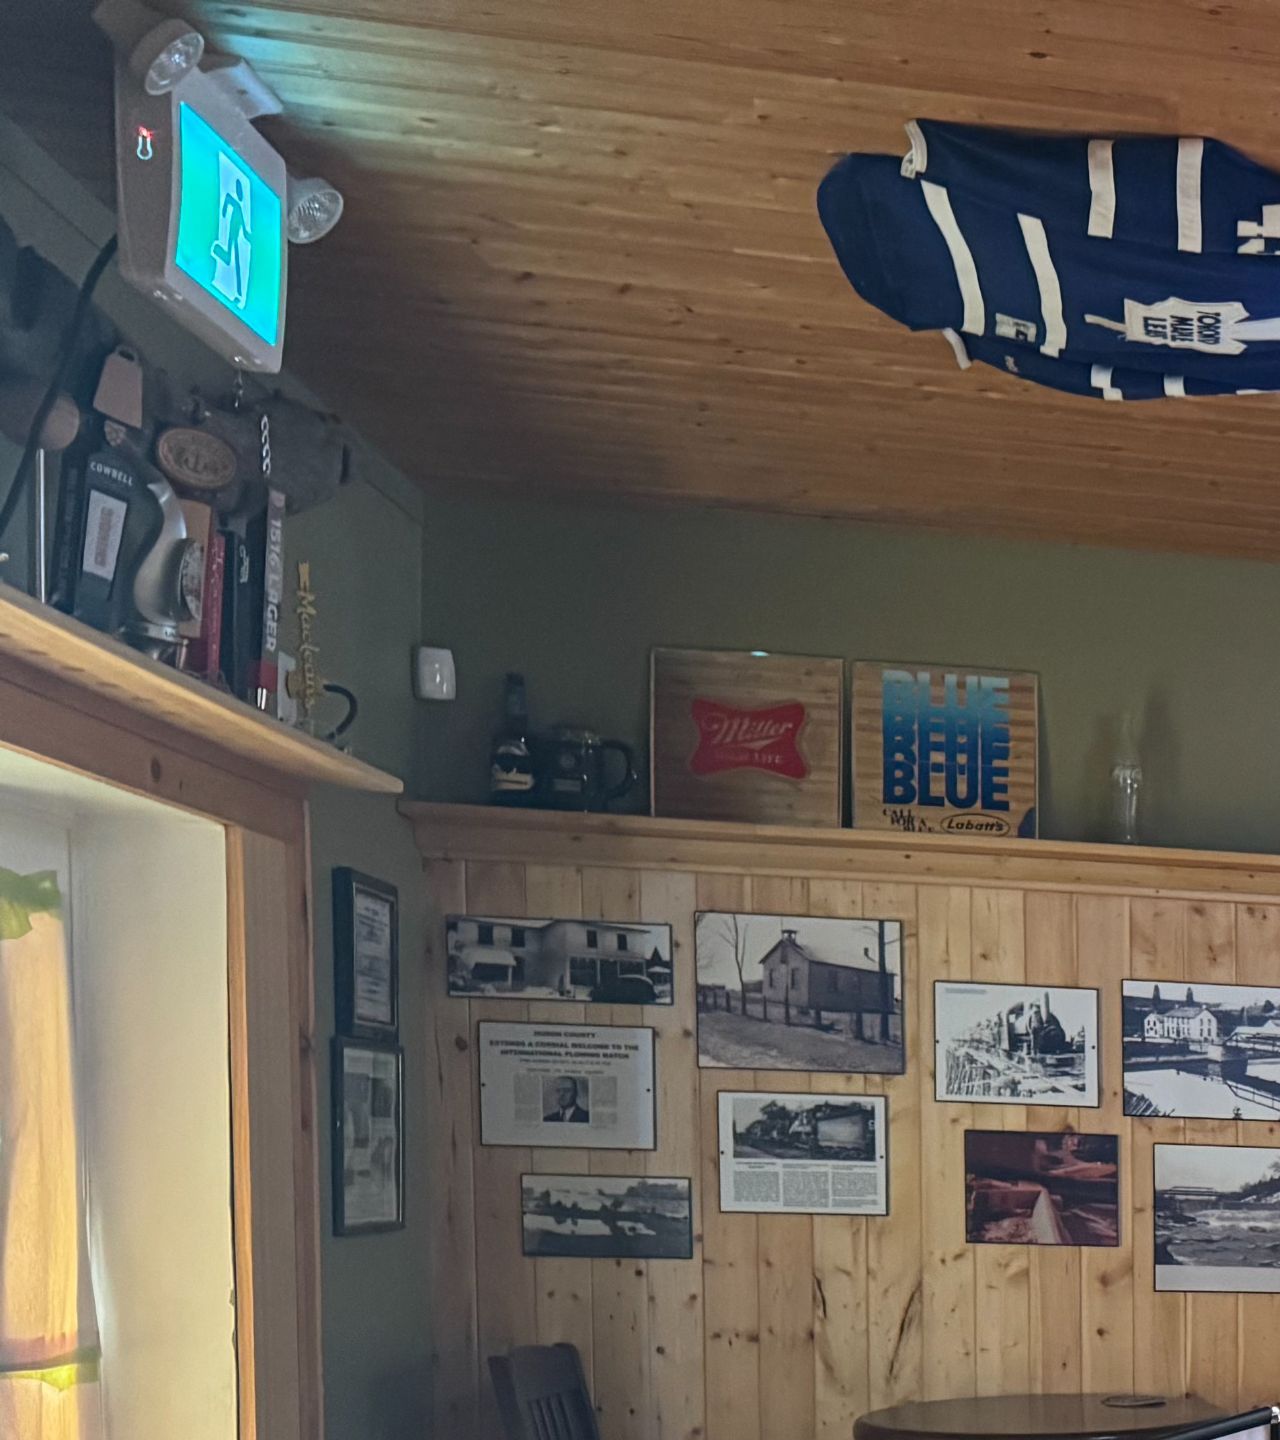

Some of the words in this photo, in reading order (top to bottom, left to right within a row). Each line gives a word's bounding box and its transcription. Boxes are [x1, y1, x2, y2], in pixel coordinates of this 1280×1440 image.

[89, 460, 134, 487] COWBELL
[264, 572, 283, 653] LAGER
[708, 713, 794, 746] Miller
[881, 763, 1011, 812] BLUE
[946, 818, 1005, 832] Labatt's
